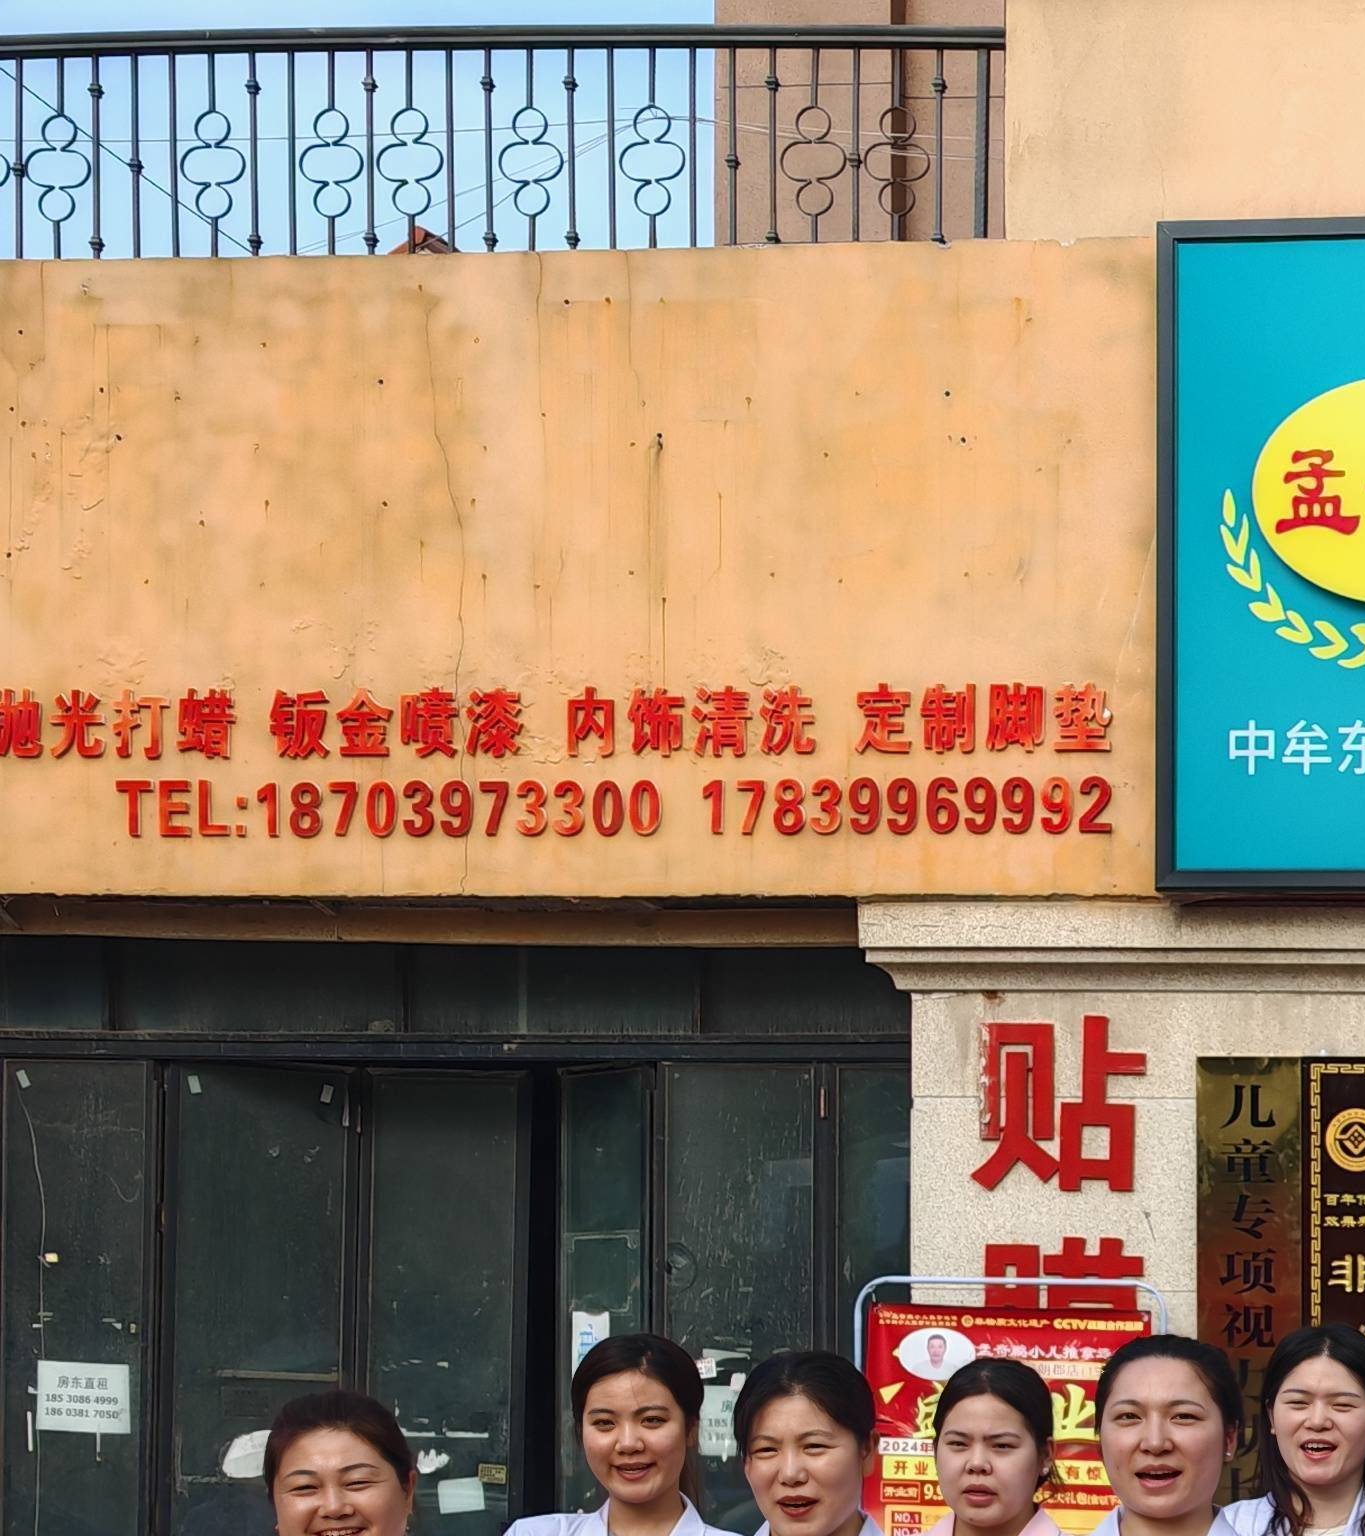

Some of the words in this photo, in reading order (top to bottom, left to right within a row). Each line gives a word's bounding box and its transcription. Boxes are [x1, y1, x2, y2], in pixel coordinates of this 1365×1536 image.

[269, 687, 524, 759] 钣金喷漆
[566, 685, 817, 757] 内饰清洗
[855, 682, 1112, 753] 定制脚垫
[116, 778, 662, 839] TEL:18703973300
[702, 776, 1112, 835] 17839969992
[57, 1375, 108, 1390] 房东直租
[44, 1393, 63, 1403] 185
[44, 1407, 63, 1416] 186
[894, 1512, 919, 1523] NO.1
